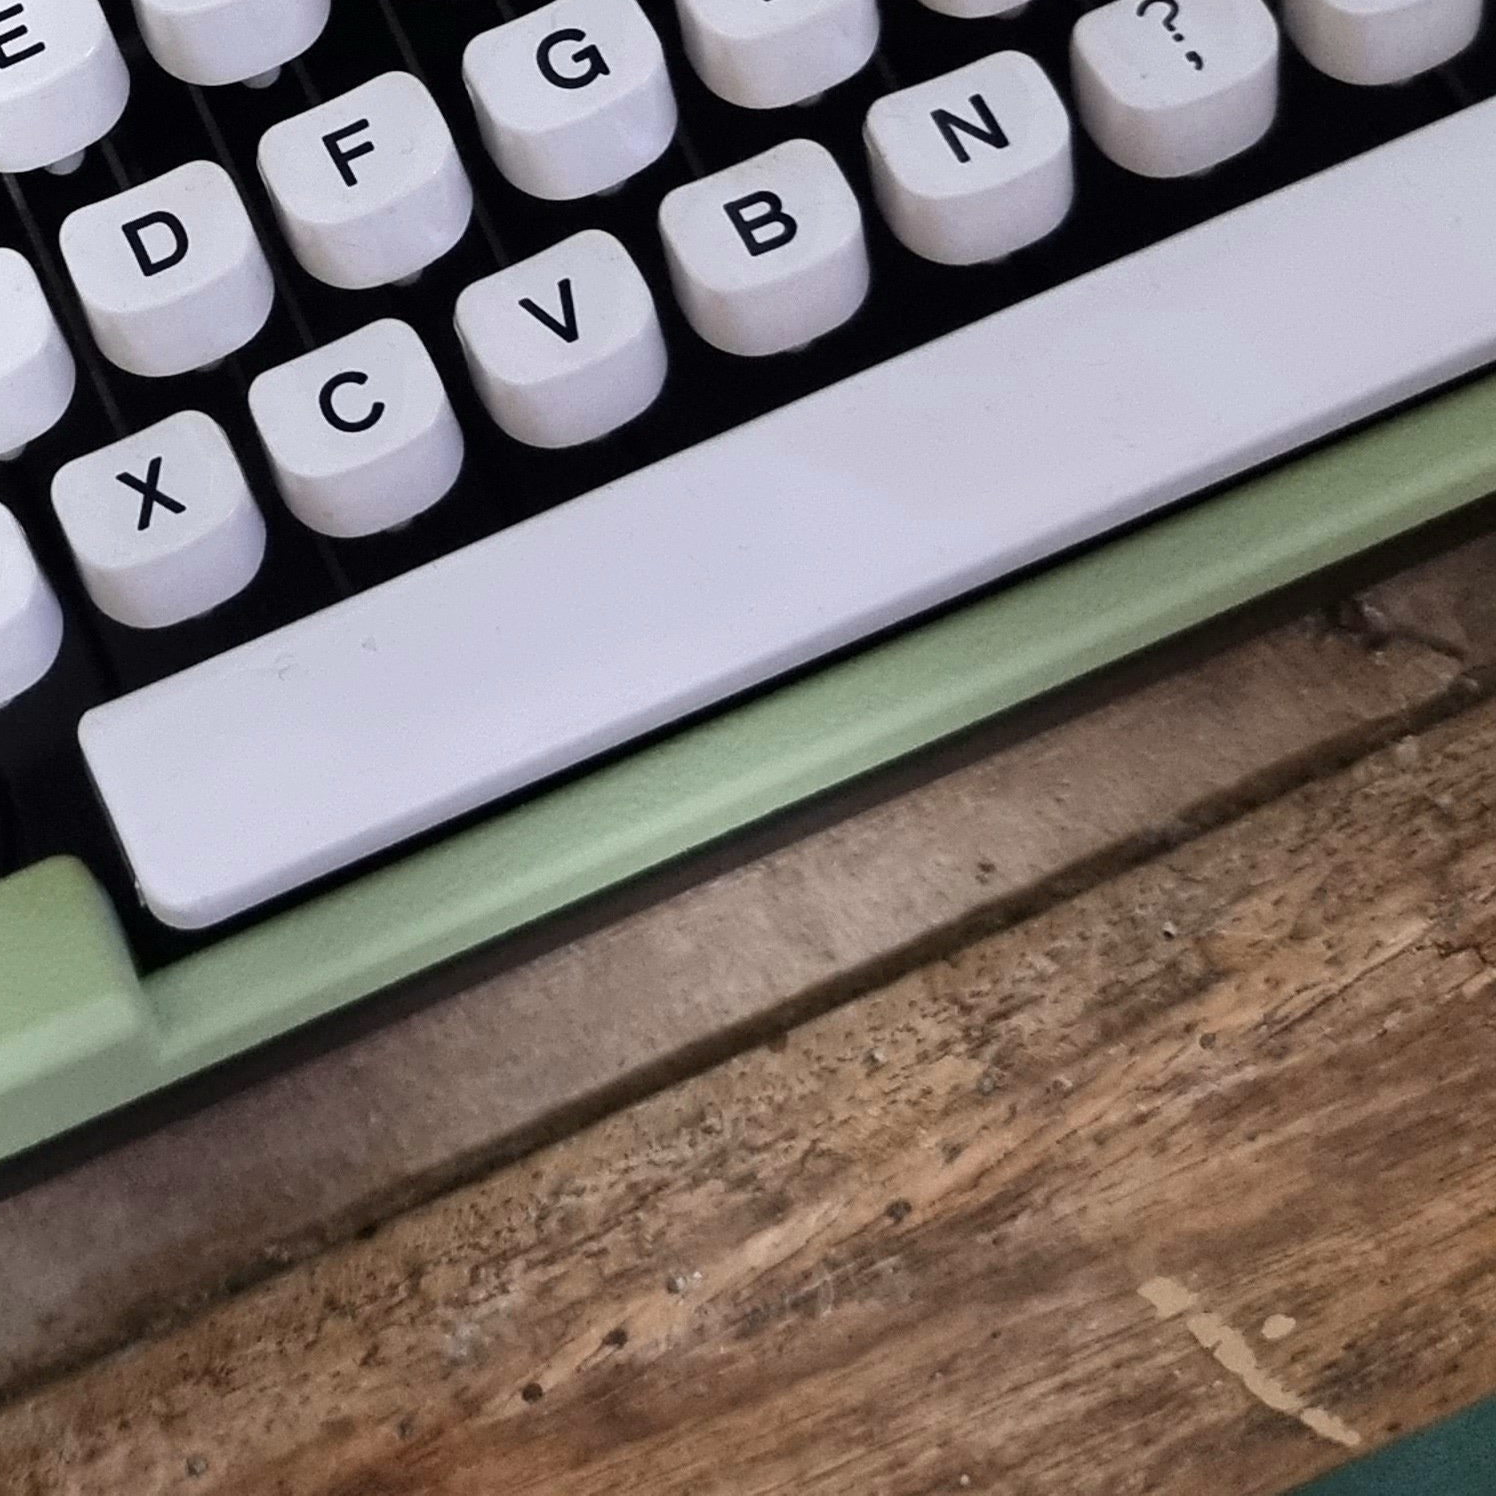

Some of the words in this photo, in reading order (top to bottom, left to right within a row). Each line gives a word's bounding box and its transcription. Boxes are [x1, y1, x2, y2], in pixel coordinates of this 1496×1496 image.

[536, 29, 610, 89] G
[322, 119, 374, 187] F
[931, 94, 1010, 163] N
[122, 211, 188, 277] D
[723, 191, 797, 256] B
[519, 278, 579, 343] V
[319, 371, 385, 433] C
[116, 457, 186, 531] X
